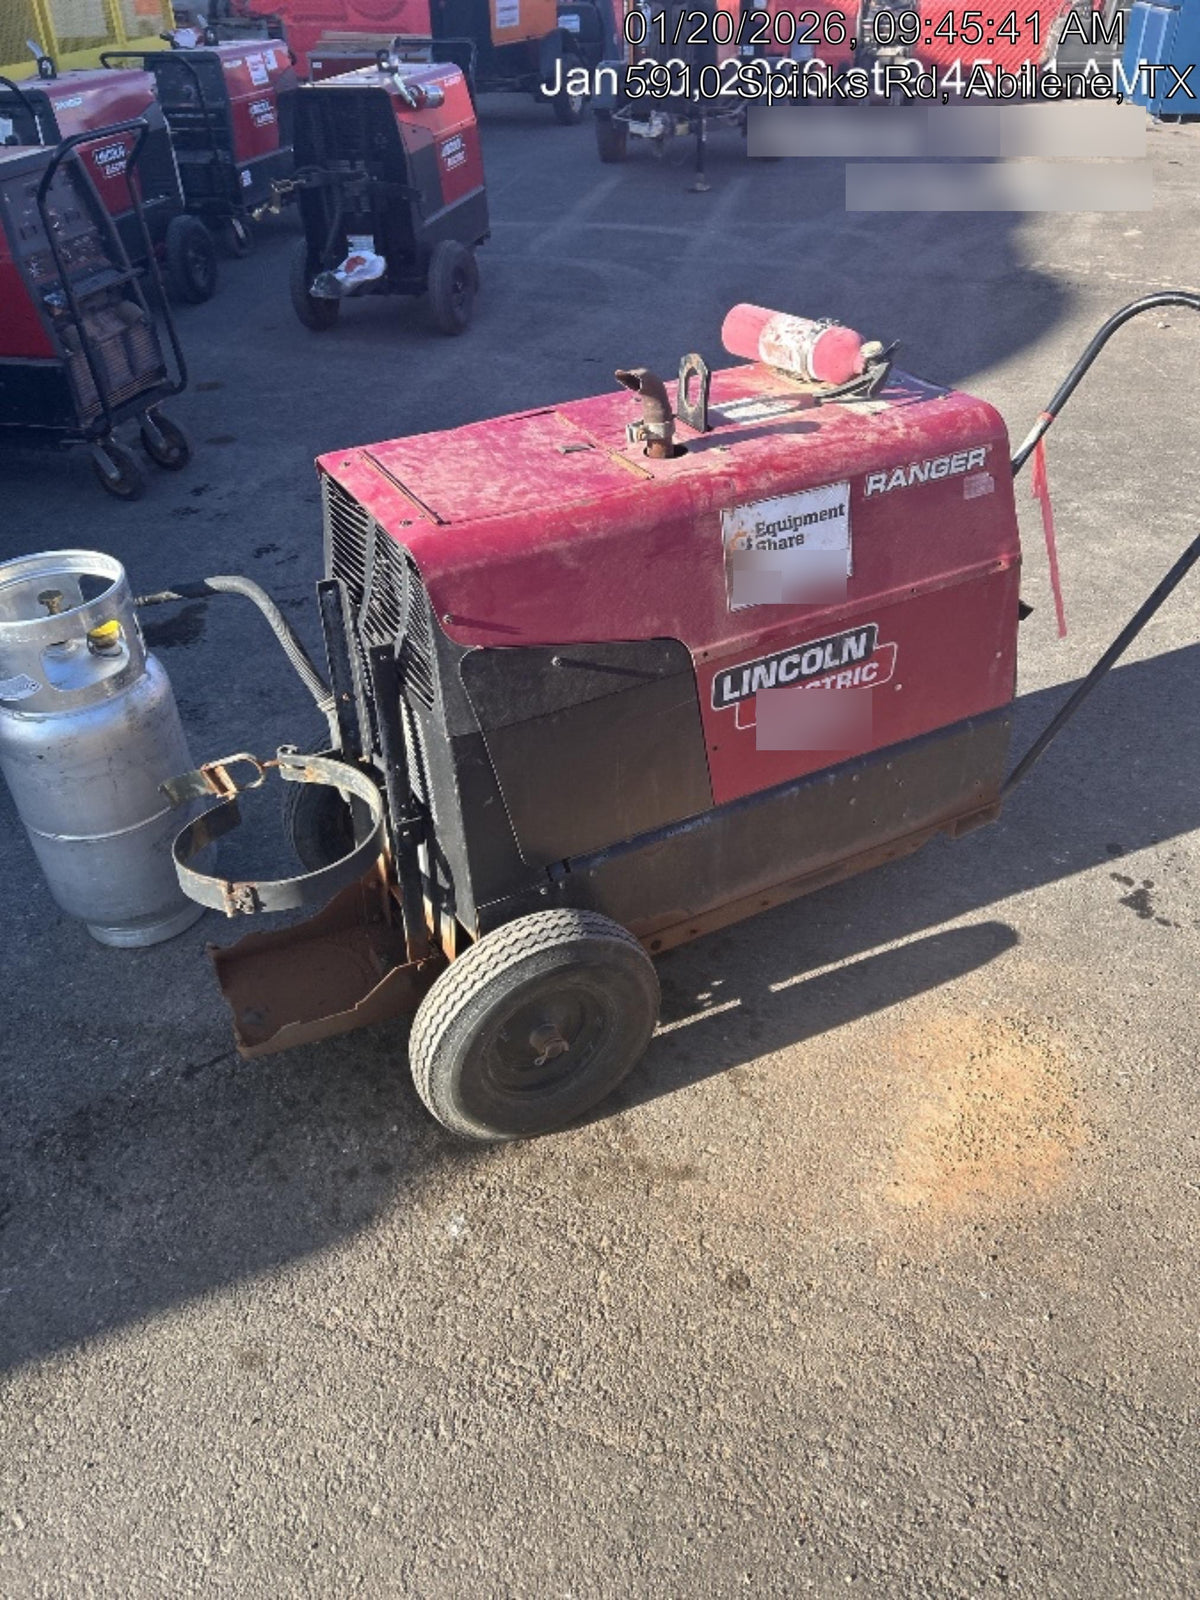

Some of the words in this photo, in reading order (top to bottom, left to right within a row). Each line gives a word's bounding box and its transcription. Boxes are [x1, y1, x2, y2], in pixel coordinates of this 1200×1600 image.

[864, 446, 987, 497] RANGER
[755, 502, 846, 539] Equipment
[755, 532, 805, 550] Share
[722, 632, 867, 701] LINCOLN
